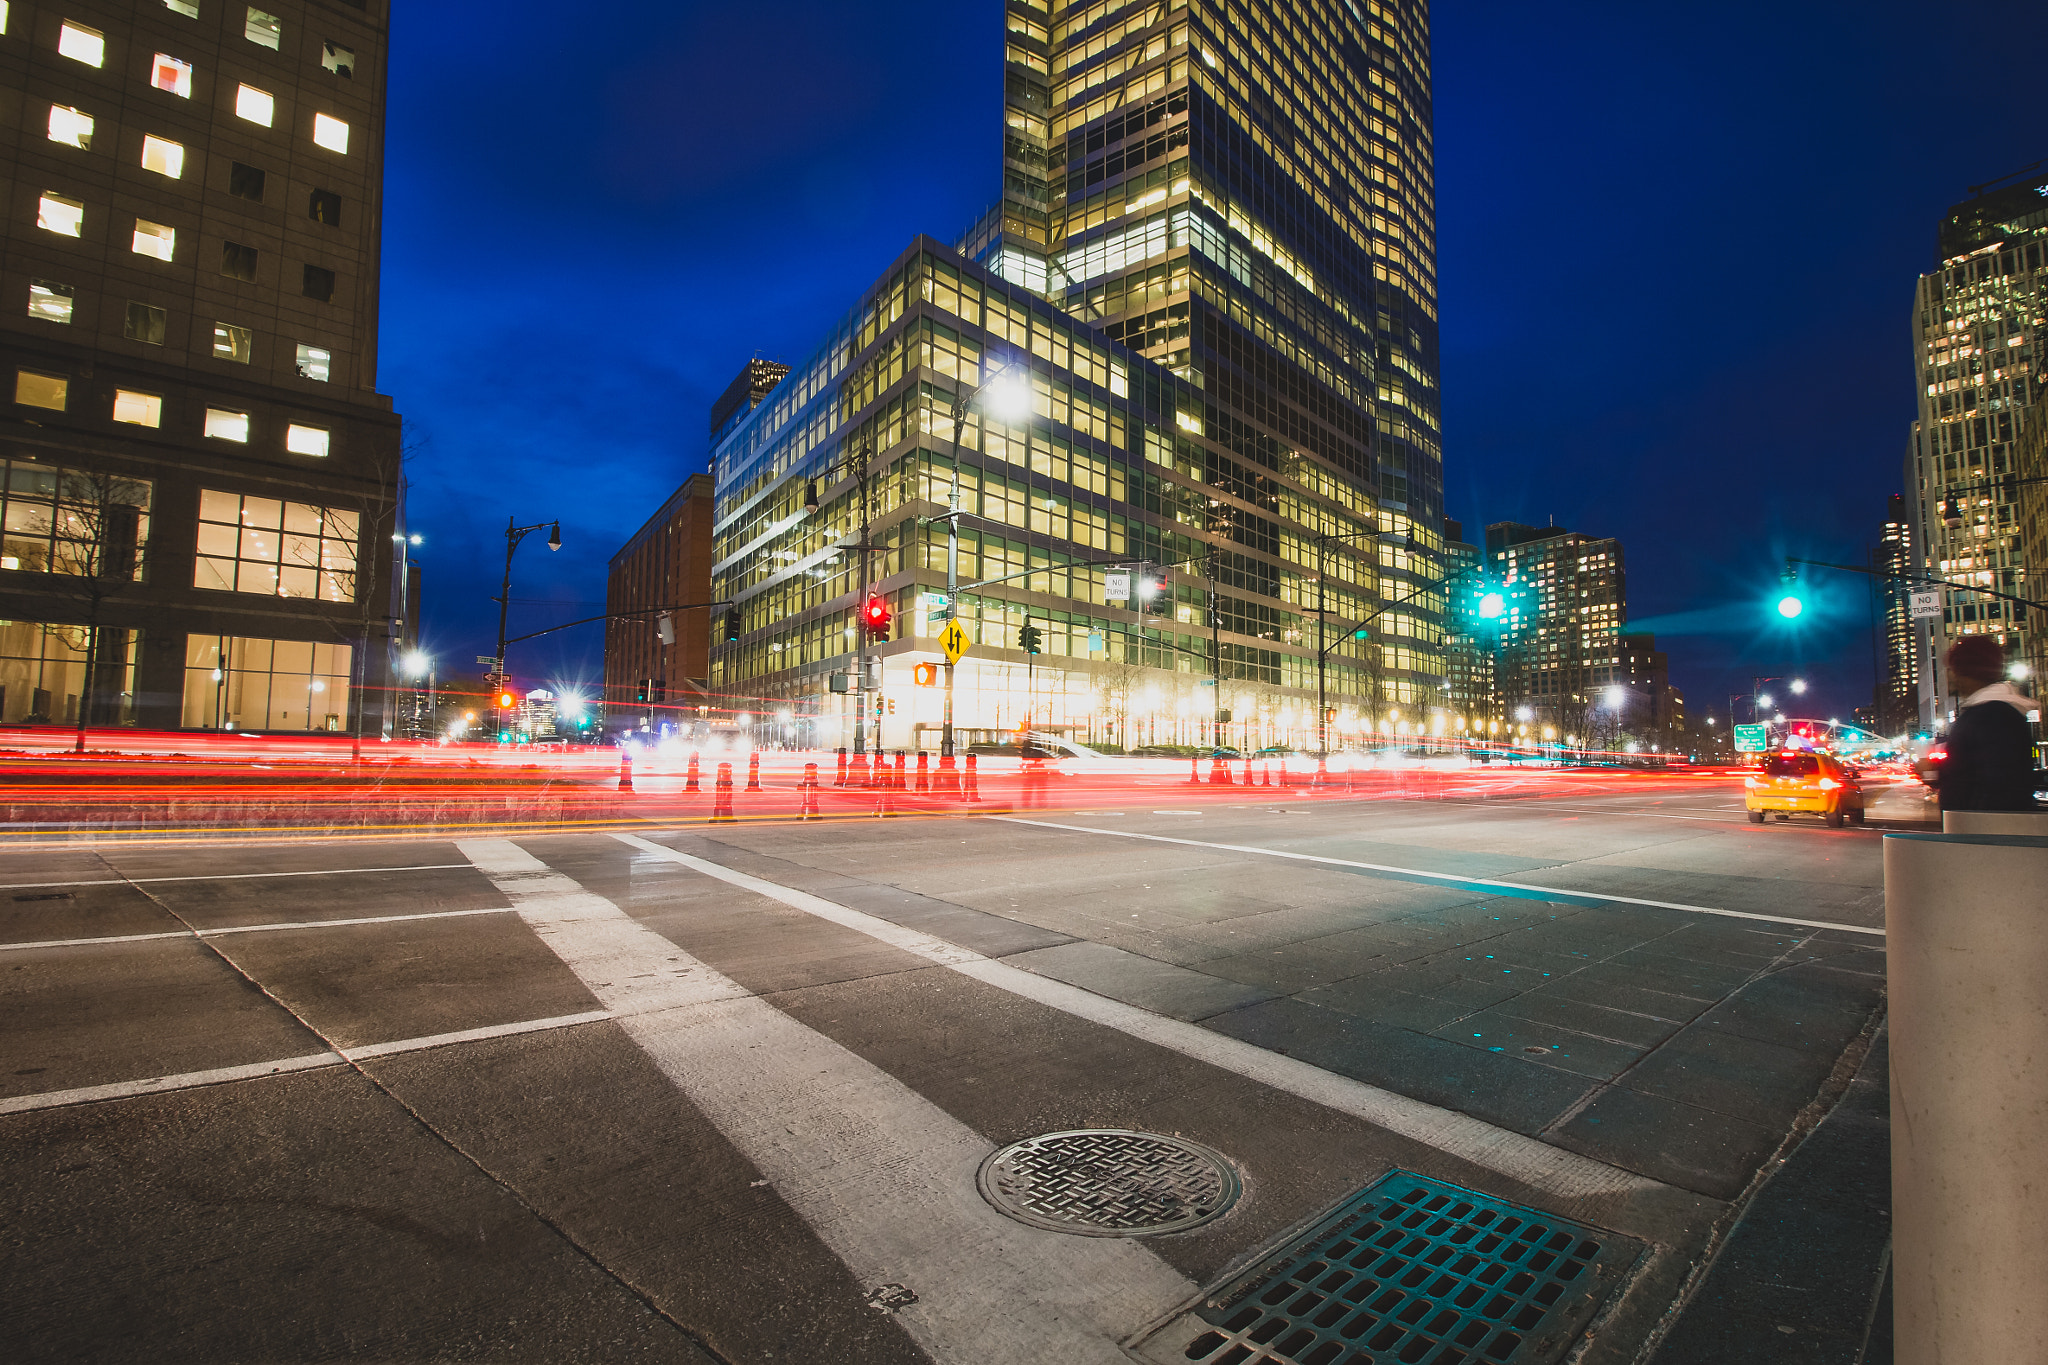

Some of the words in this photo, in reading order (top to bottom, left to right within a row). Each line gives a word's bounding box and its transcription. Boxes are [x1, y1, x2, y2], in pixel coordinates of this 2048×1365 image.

[1107, 588, 1128, 596] TURNS
[1918, 596, 1932, 604] NO
[1912, 605, 1940, 614] TURNS
